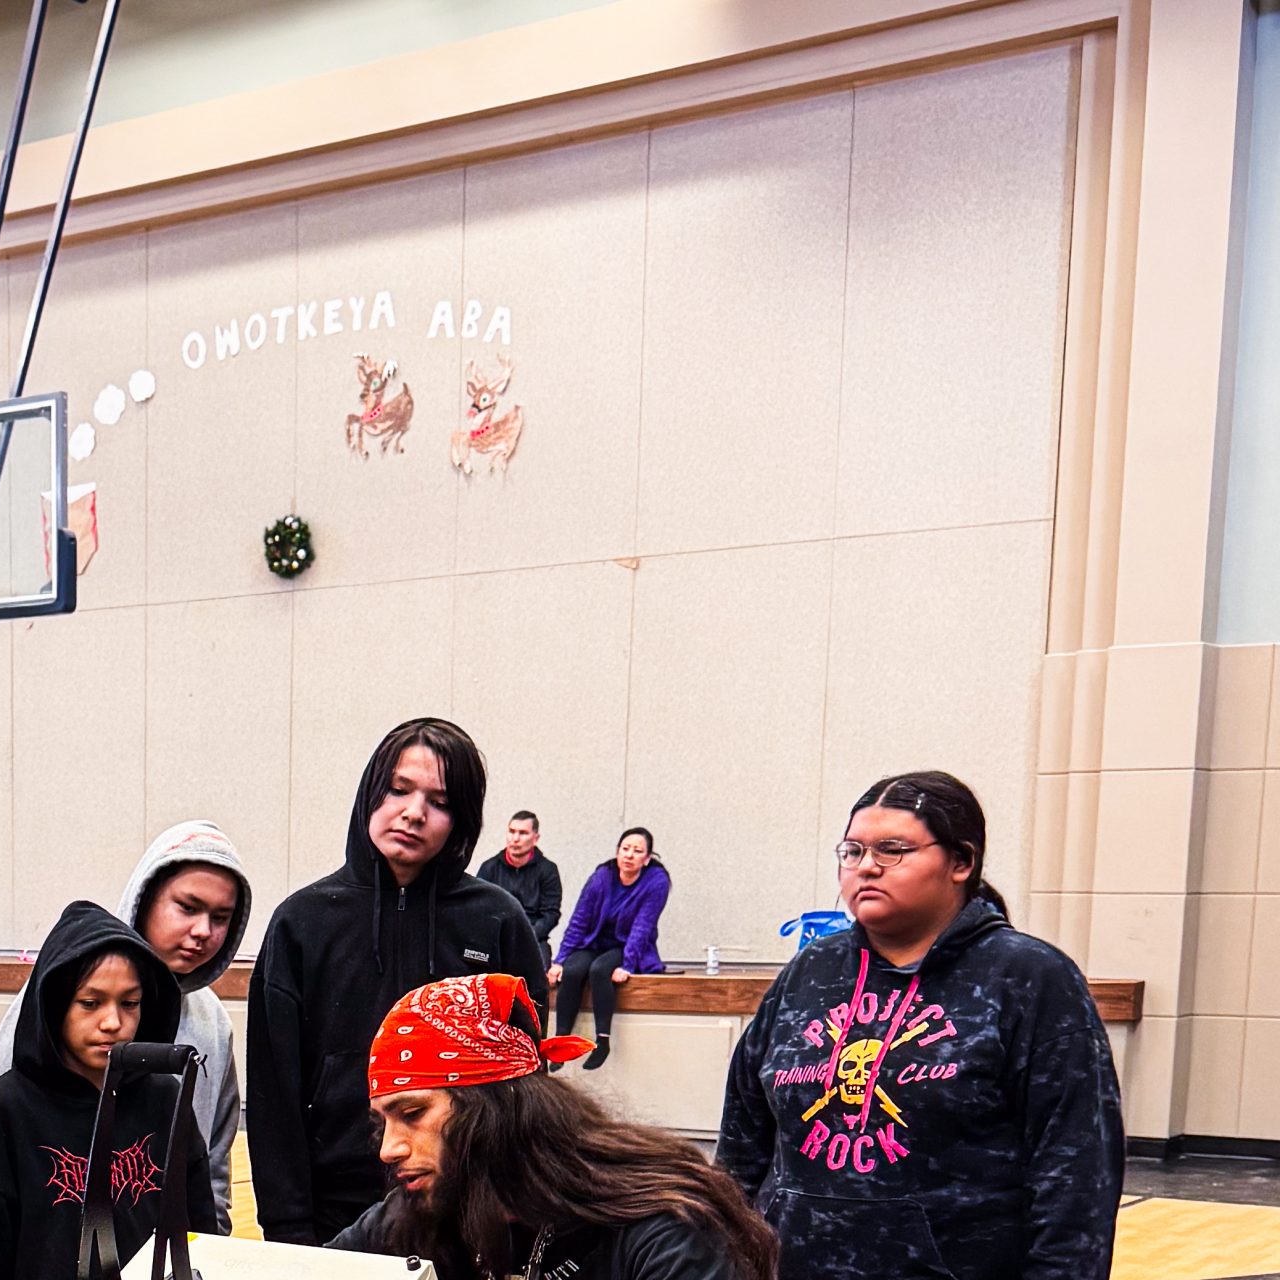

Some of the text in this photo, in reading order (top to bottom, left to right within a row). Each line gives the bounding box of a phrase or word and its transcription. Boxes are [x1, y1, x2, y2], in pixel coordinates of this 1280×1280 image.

[181, 291, 511, 369] OWOTKEYA ABA
[773, 1063, 958, 1089] TRAINING CLUB
[800, 1120, 910, 1174] ROCK
